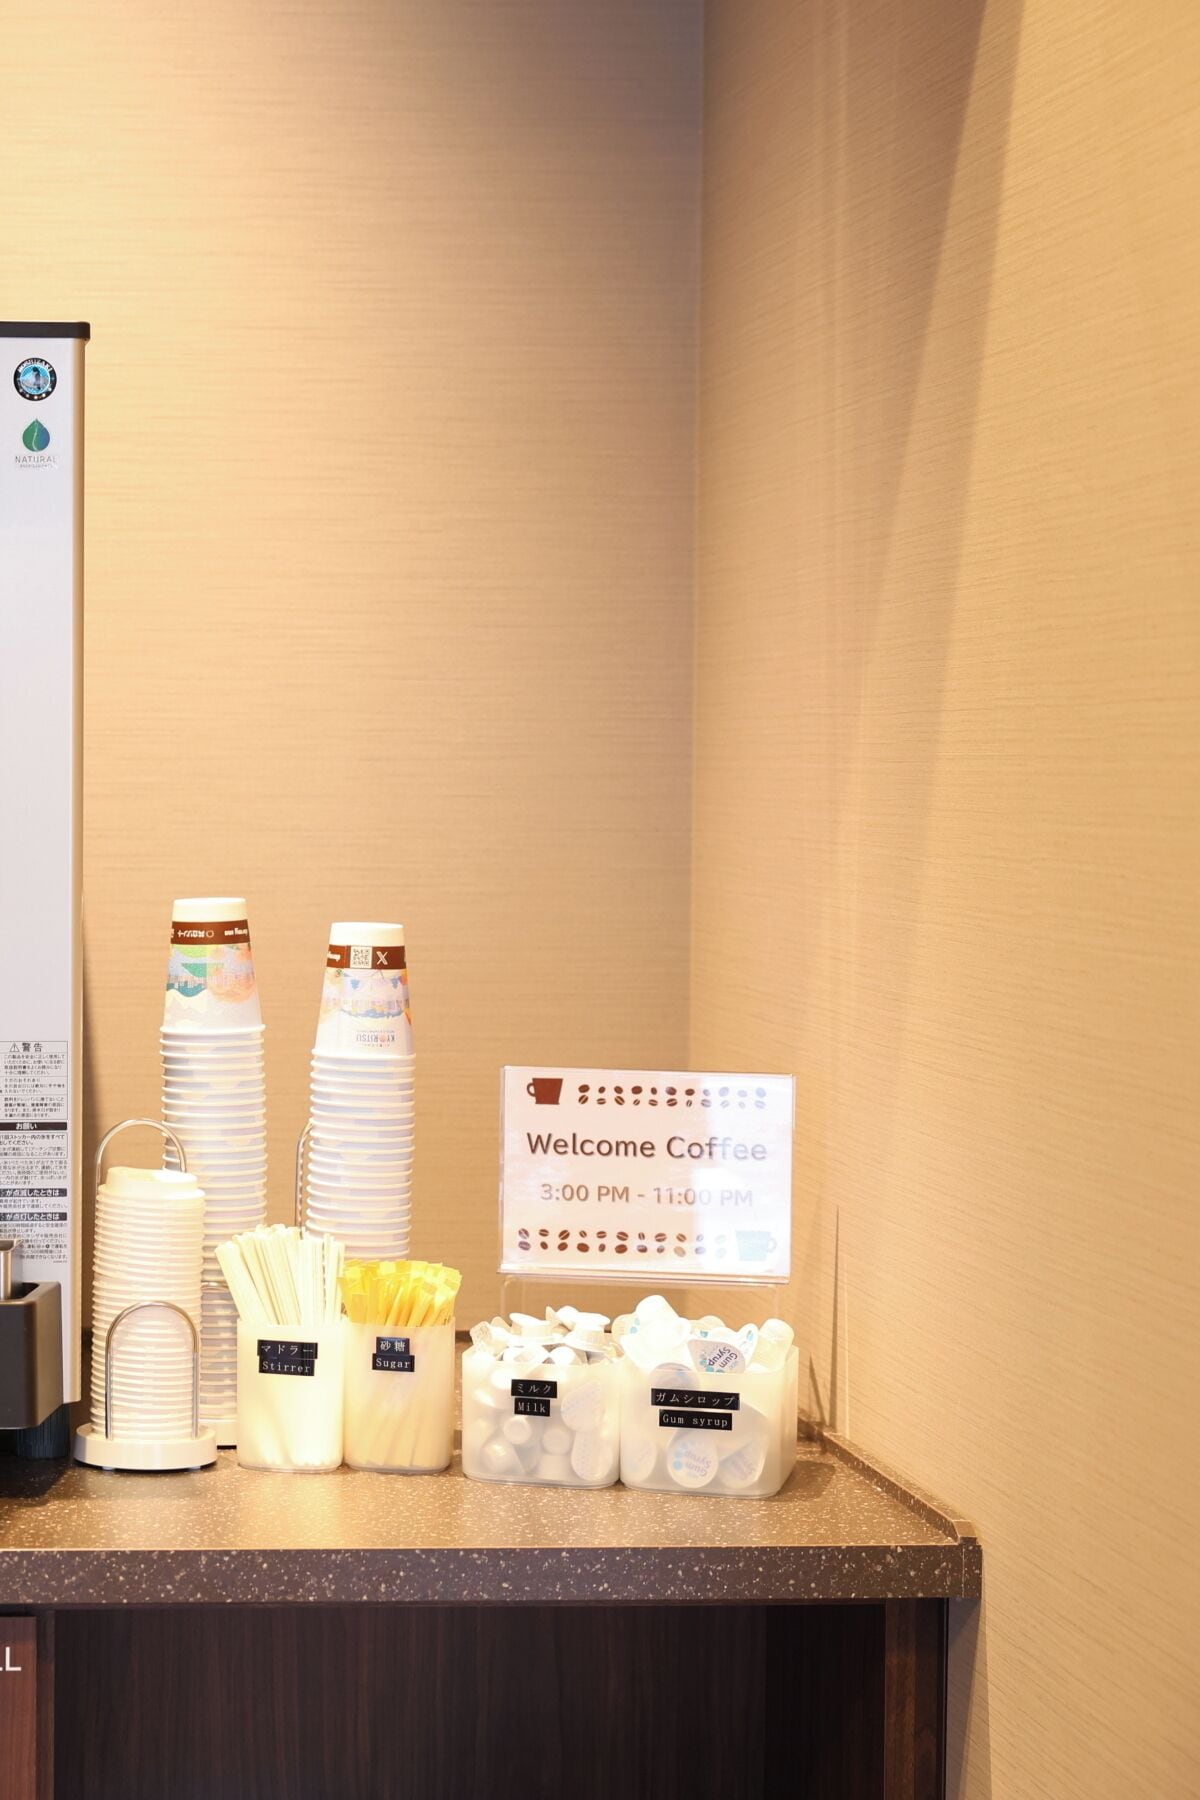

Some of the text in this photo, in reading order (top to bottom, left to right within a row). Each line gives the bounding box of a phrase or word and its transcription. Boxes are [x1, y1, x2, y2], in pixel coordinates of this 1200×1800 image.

[527, 1132, 768, 1161] Welcome Coffee
[541, 1183, 589, 1202] 3:00
[597, 1185, 631, 1203] PM
[653, 1187, 711, 1205] 11:00
[720, 1189, 753, 1207] PM
[260, 1343, 314, 1355] マドラー
[379, 1340, 406, 1352] 砂糖
[708, 1346, 731, 1366] Syrup
[719, 1352, 738, 1368] Gum
[262, 1360, 311, 1373] Stirrer
[375, 1358, 411, 1369] Sugar
[517, 1383, 551, 1394] ミルク
[656, 1391, 735, 1406] ガムシロップ
[517, 1402, 546, 1414] Milk
[662, 1413, 728, 1428] Gum syrup
